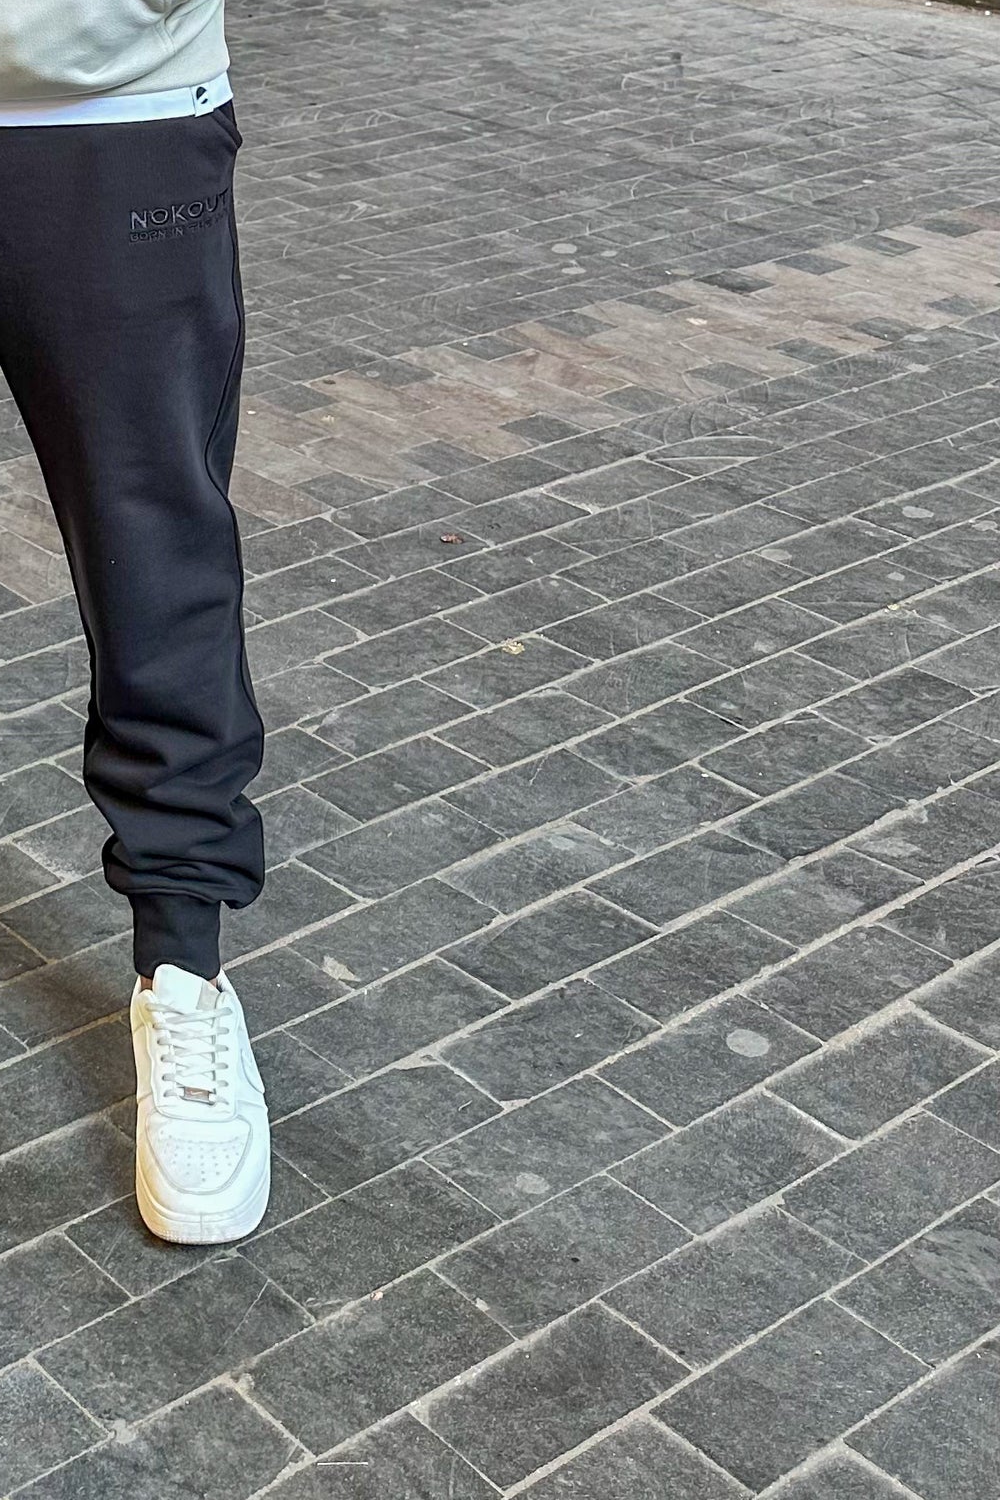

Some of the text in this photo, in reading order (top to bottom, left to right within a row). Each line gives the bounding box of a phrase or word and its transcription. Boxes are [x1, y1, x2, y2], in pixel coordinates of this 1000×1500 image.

[130, 188, 229, 230] NOKOUT
[130, 228, 166, 242] BORN
[172, 226, 184, 237] IN
